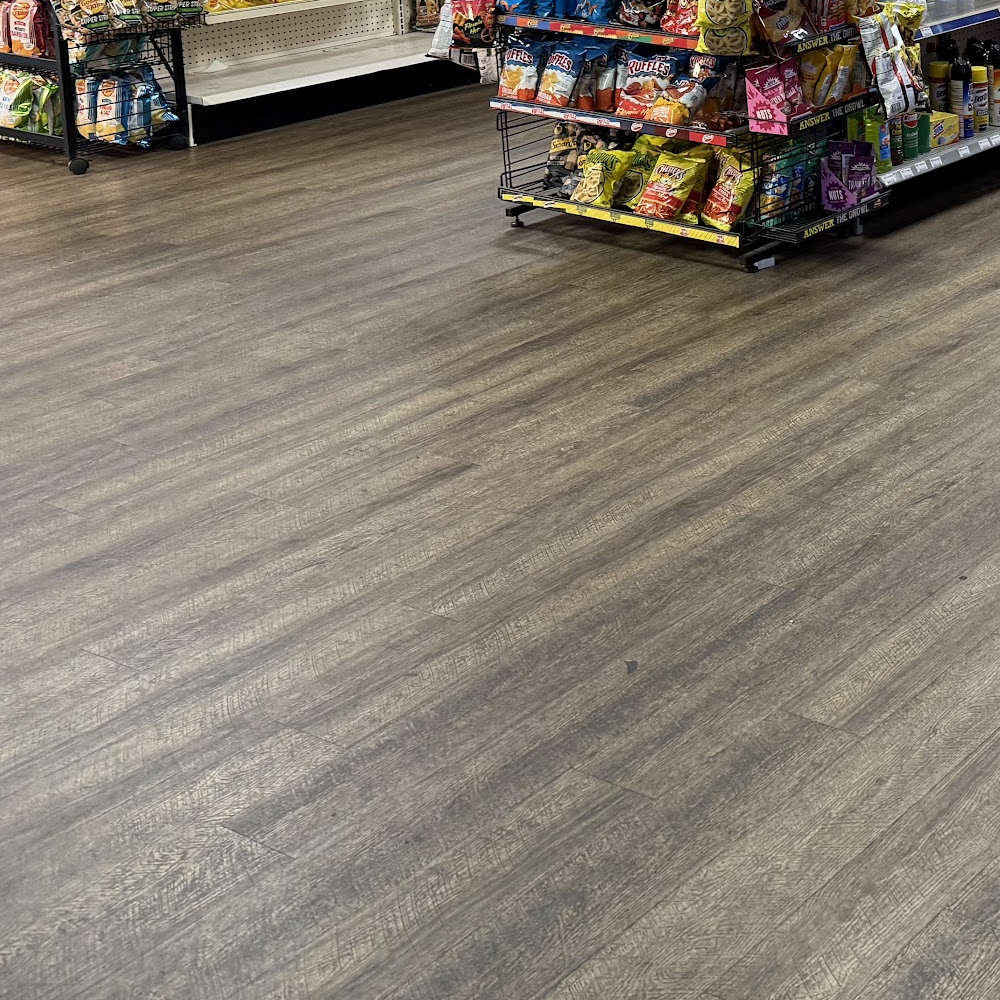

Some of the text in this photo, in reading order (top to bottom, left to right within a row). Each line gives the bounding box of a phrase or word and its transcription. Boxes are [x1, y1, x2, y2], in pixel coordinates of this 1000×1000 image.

[797, 37, 829, 52] ANSWER
[830, 32, 842, 42] THE
[506, 47, 534, 65] UFFLES
[548, 52, 573, 71] UFFLES
[628, 59, 670, 77] RUFFLES
[756, 109, 773, 120] NUTS
[799, 98, 866, 131] ANSWER THE GROWL
[828, 189, 844, 201] NUTS
[803, 205, 870, 239] ANSWER THE GROWL
